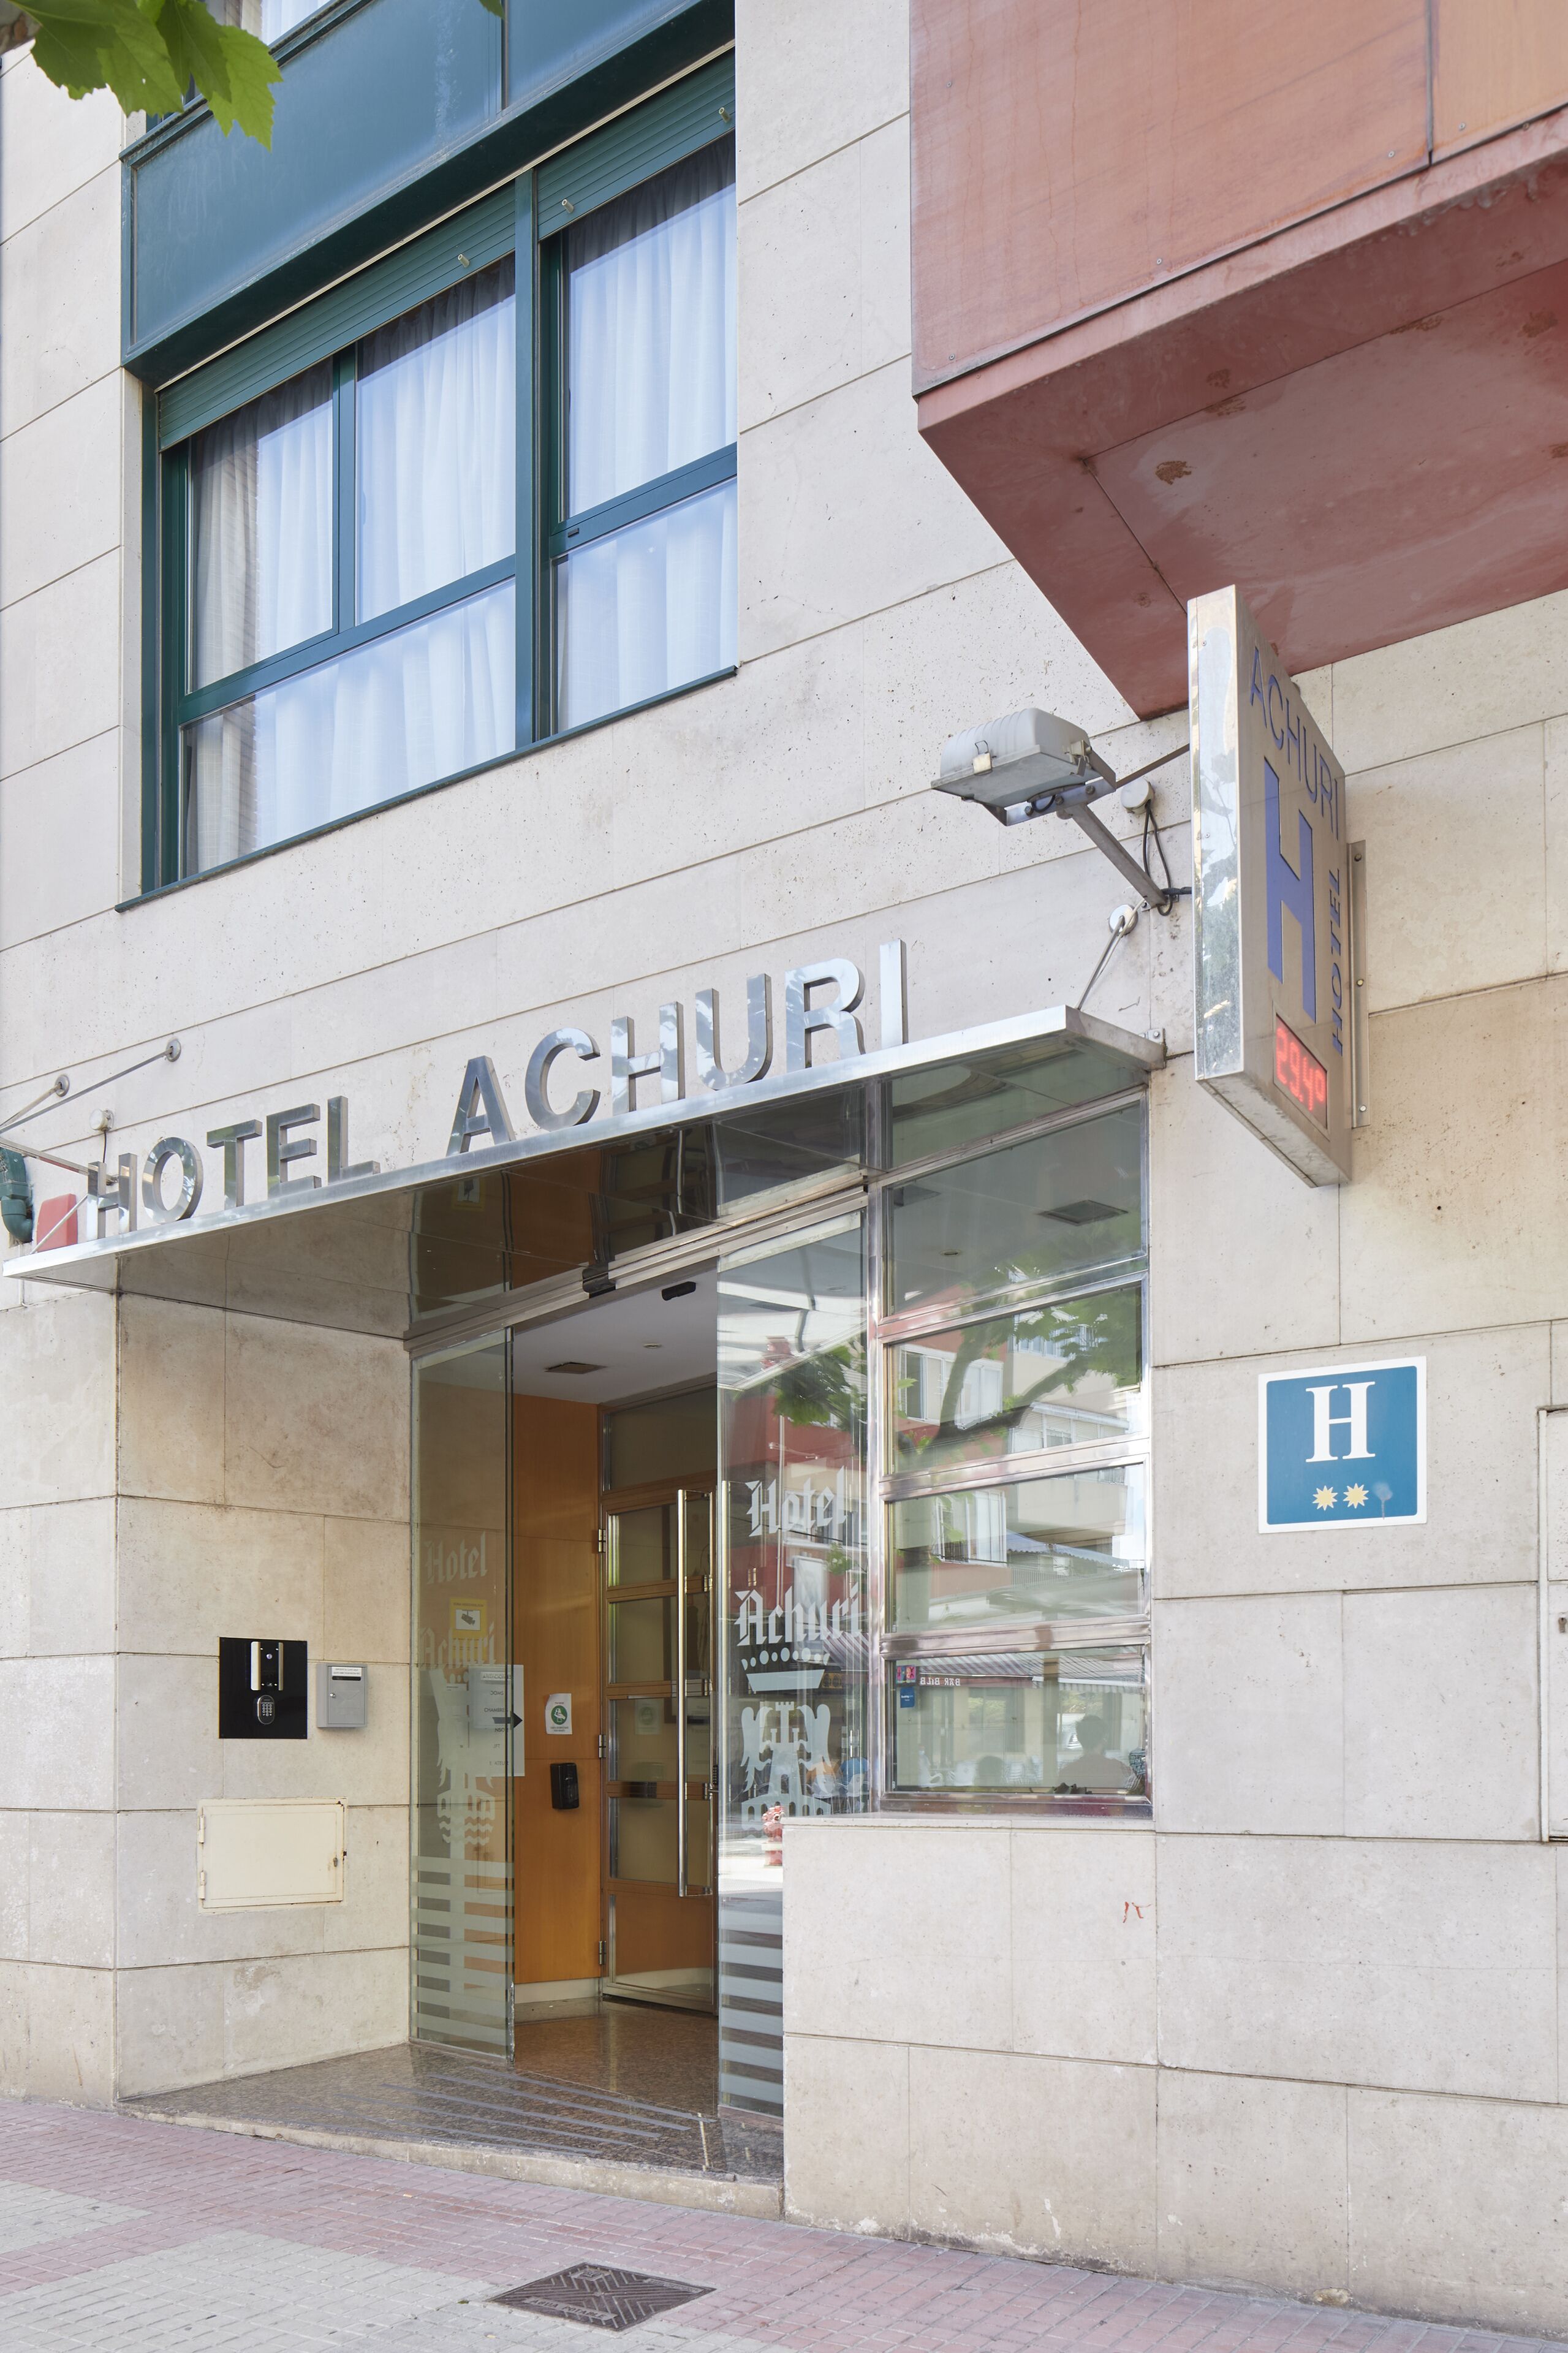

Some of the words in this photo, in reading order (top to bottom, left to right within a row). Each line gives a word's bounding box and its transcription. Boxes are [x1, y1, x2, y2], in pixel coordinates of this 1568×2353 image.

[1250, 646, 1338, 841] ACHURI
[1328, 868, 1343, 1057] HOTEL
[87, 1095, 381, 1240] HOTEL
[446, 938, 909, 1157] ACHURI
[1306, 1381, 1376, 1463] H
[744, 1465, 849, 1537] Hotel
[425, 1530, 488, 1585] Hotel
[734, 1582, 863, 1646] Achuri
